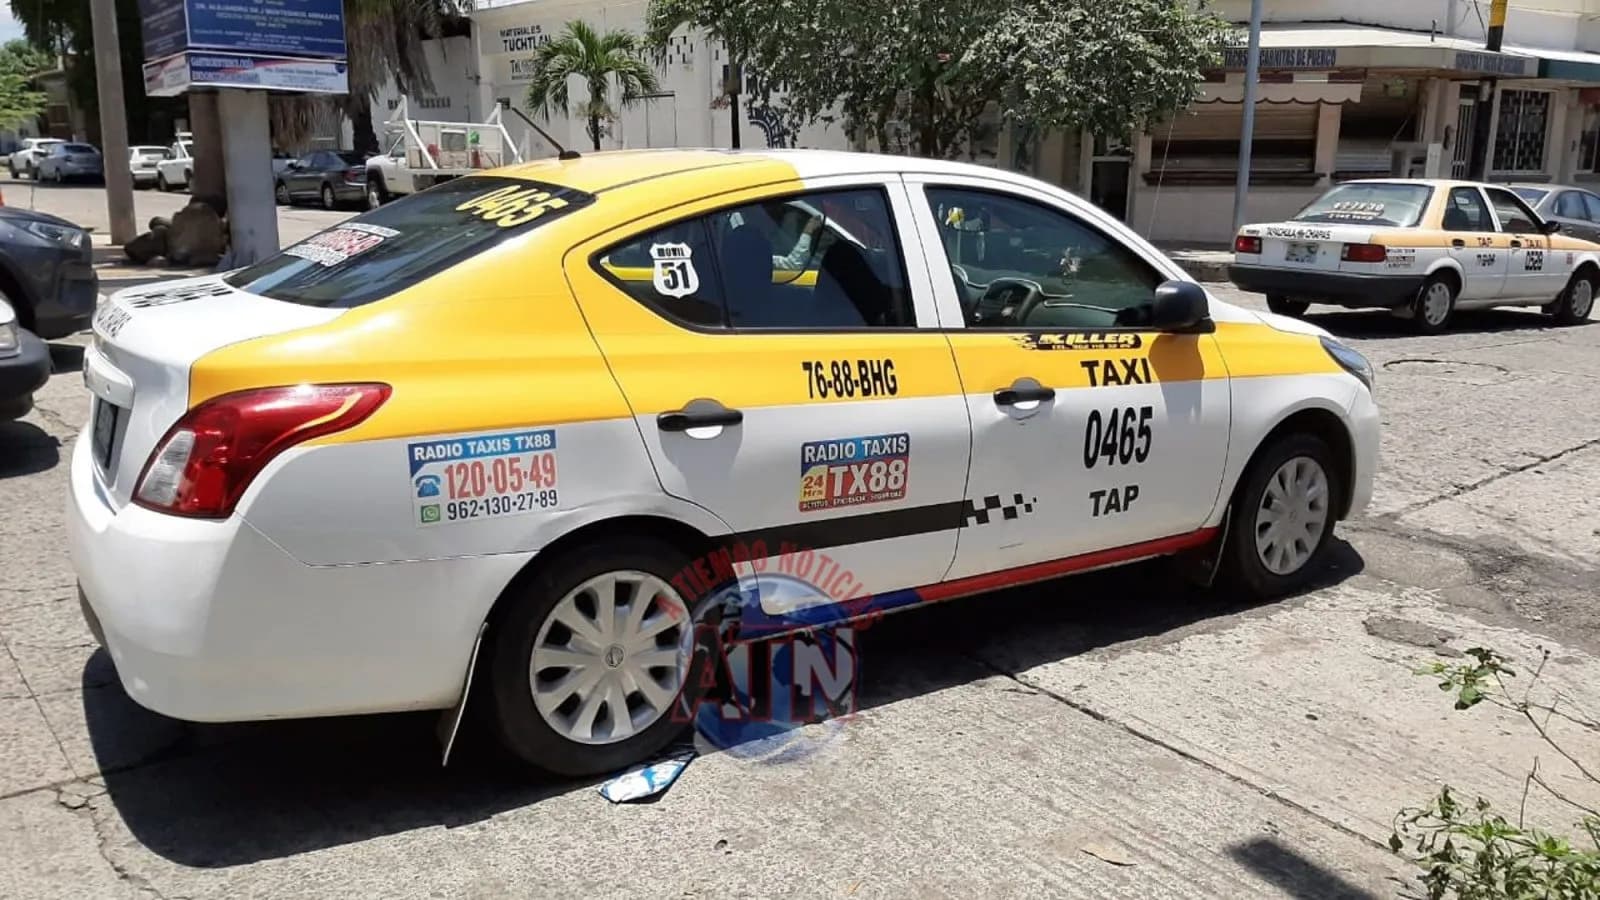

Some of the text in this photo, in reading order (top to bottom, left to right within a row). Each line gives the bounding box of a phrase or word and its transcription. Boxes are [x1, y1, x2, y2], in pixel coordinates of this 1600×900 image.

[500, 25, 542, 37] MATERIALES
[455, 184, 569, 228] 0465
[1524, 239, 1544, 249] TAXI
[661, 261, 691, 290] 51
[1038, 333, 1137, 346] KILLER
[802, 358, 898, 399] 76-88-BHG
[1080, 357, 1153, 387] TAXI
[414, 433, 552, 461] RADIO TAXIS TX88
[804, 435, 908, 463] RADIO TAXIS
[1083, 405, 1154, 469] 0465
[803, 475, 825, 490] 24
[829, 459, 907, 497] TX88
[1088, 484, 1140, 517] TAP
